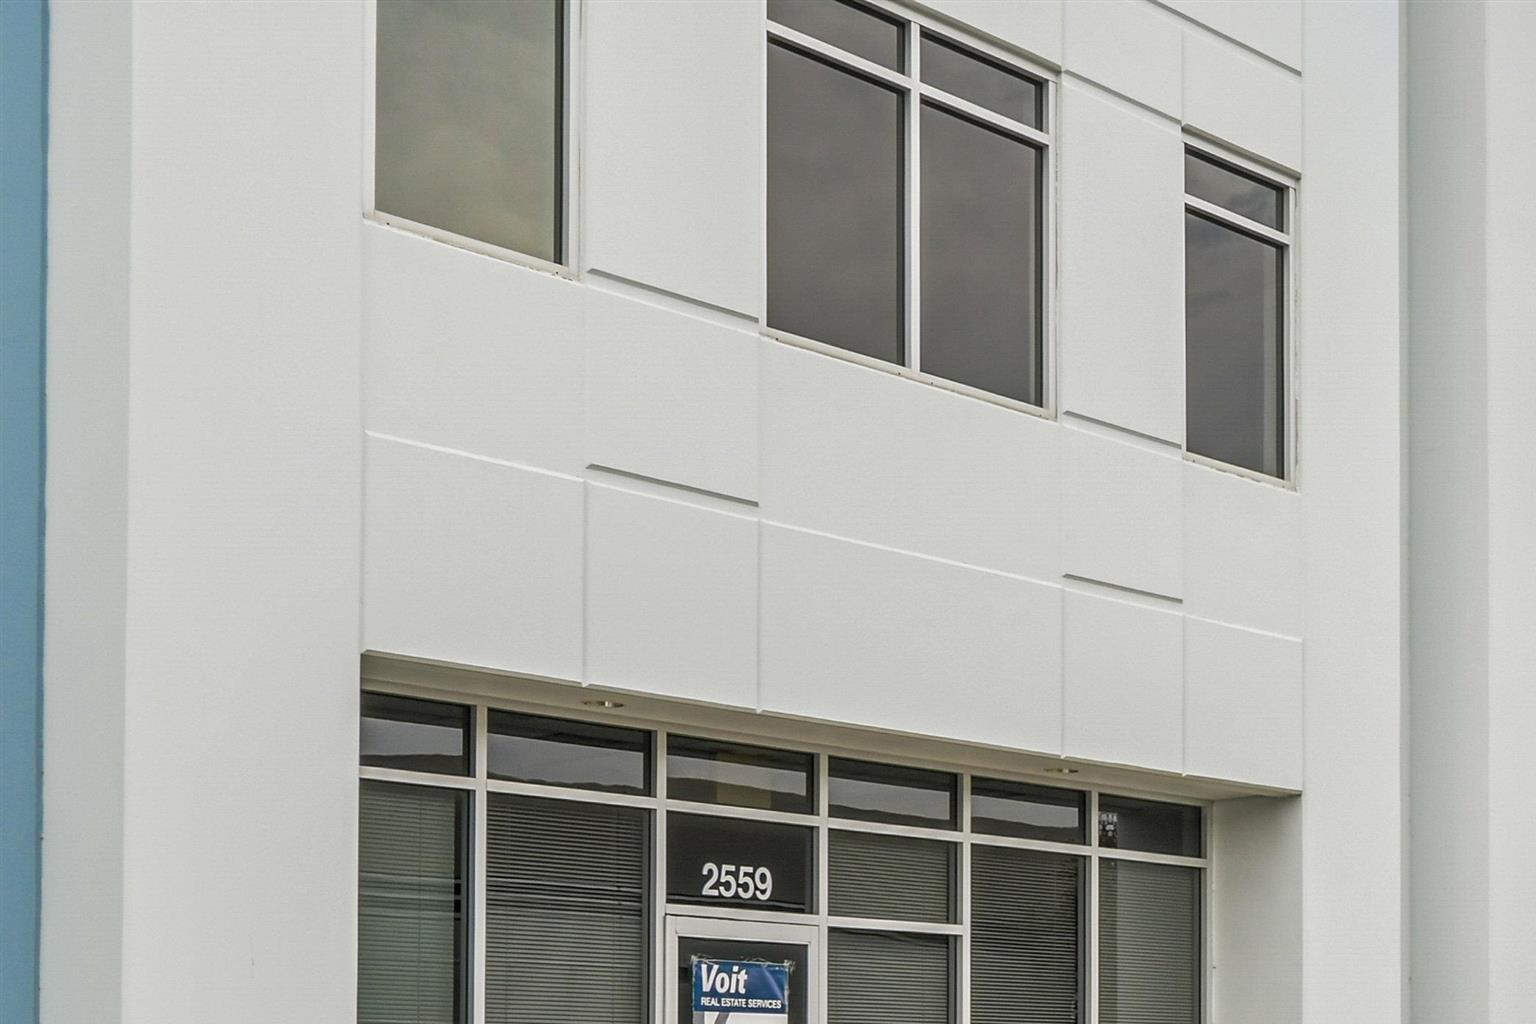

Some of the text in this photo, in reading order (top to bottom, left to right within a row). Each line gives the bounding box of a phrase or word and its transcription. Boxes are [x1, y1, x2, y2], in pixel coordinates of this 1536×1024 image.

[701, 862, 773, 901] 2559
[701, 964, 748, 994] Voit
[701, 997, 782, 1009] REAL ESTATE SERVICES
